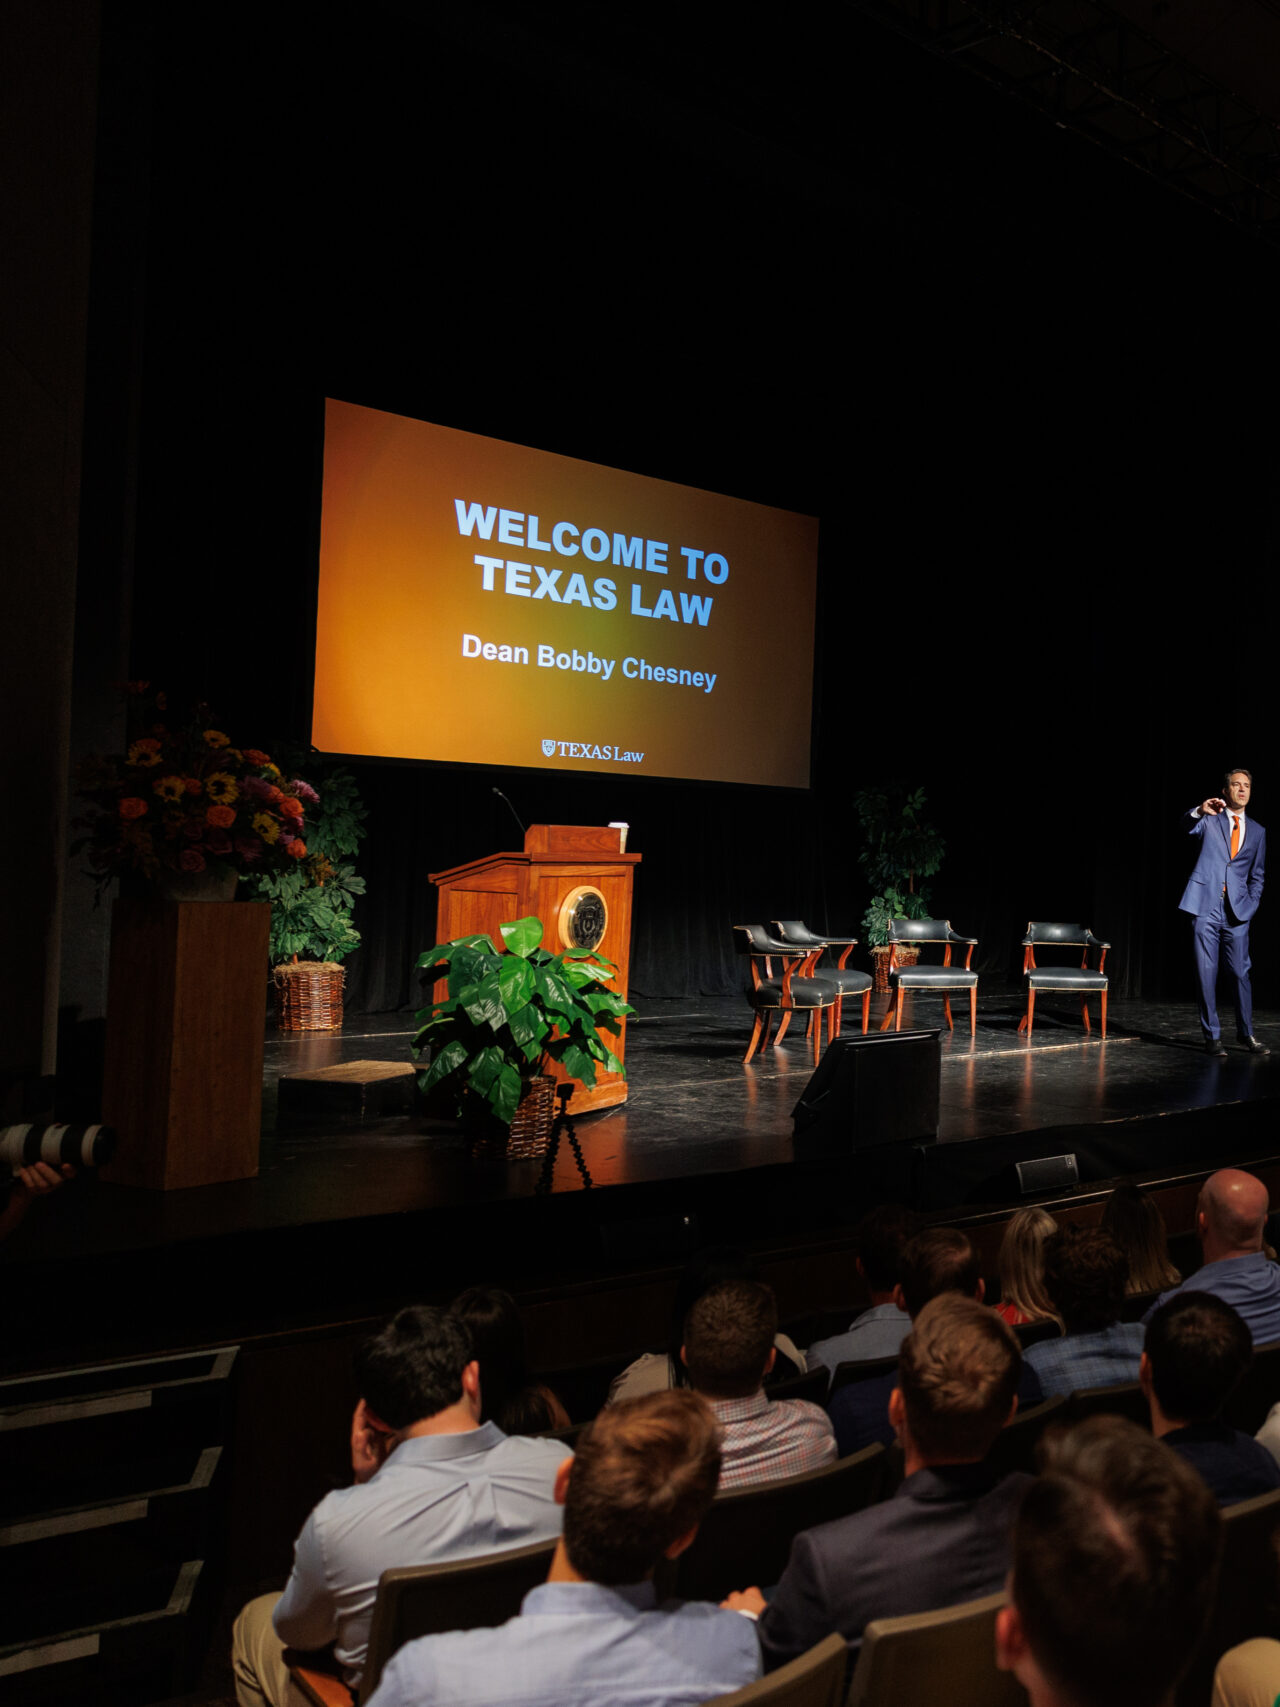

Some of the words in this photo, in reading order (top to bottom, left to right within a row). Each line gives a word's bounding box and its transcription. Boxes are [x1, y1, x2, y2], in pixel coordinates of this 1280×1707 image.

[454, 499, 669, 575] WELCOME
[681, 547, 730, 585] TO
[474, 555, 618, 611] TEXAS
[631, 584, 714, 627] LAW
[462, 633, 530, 665] Dean
[537, 644, 617, 681] Bobby
[622, 657, 717, 694] Chesney
[557, 741, 612, 761] TEXAS
[613, 746, 645, 763] Law
